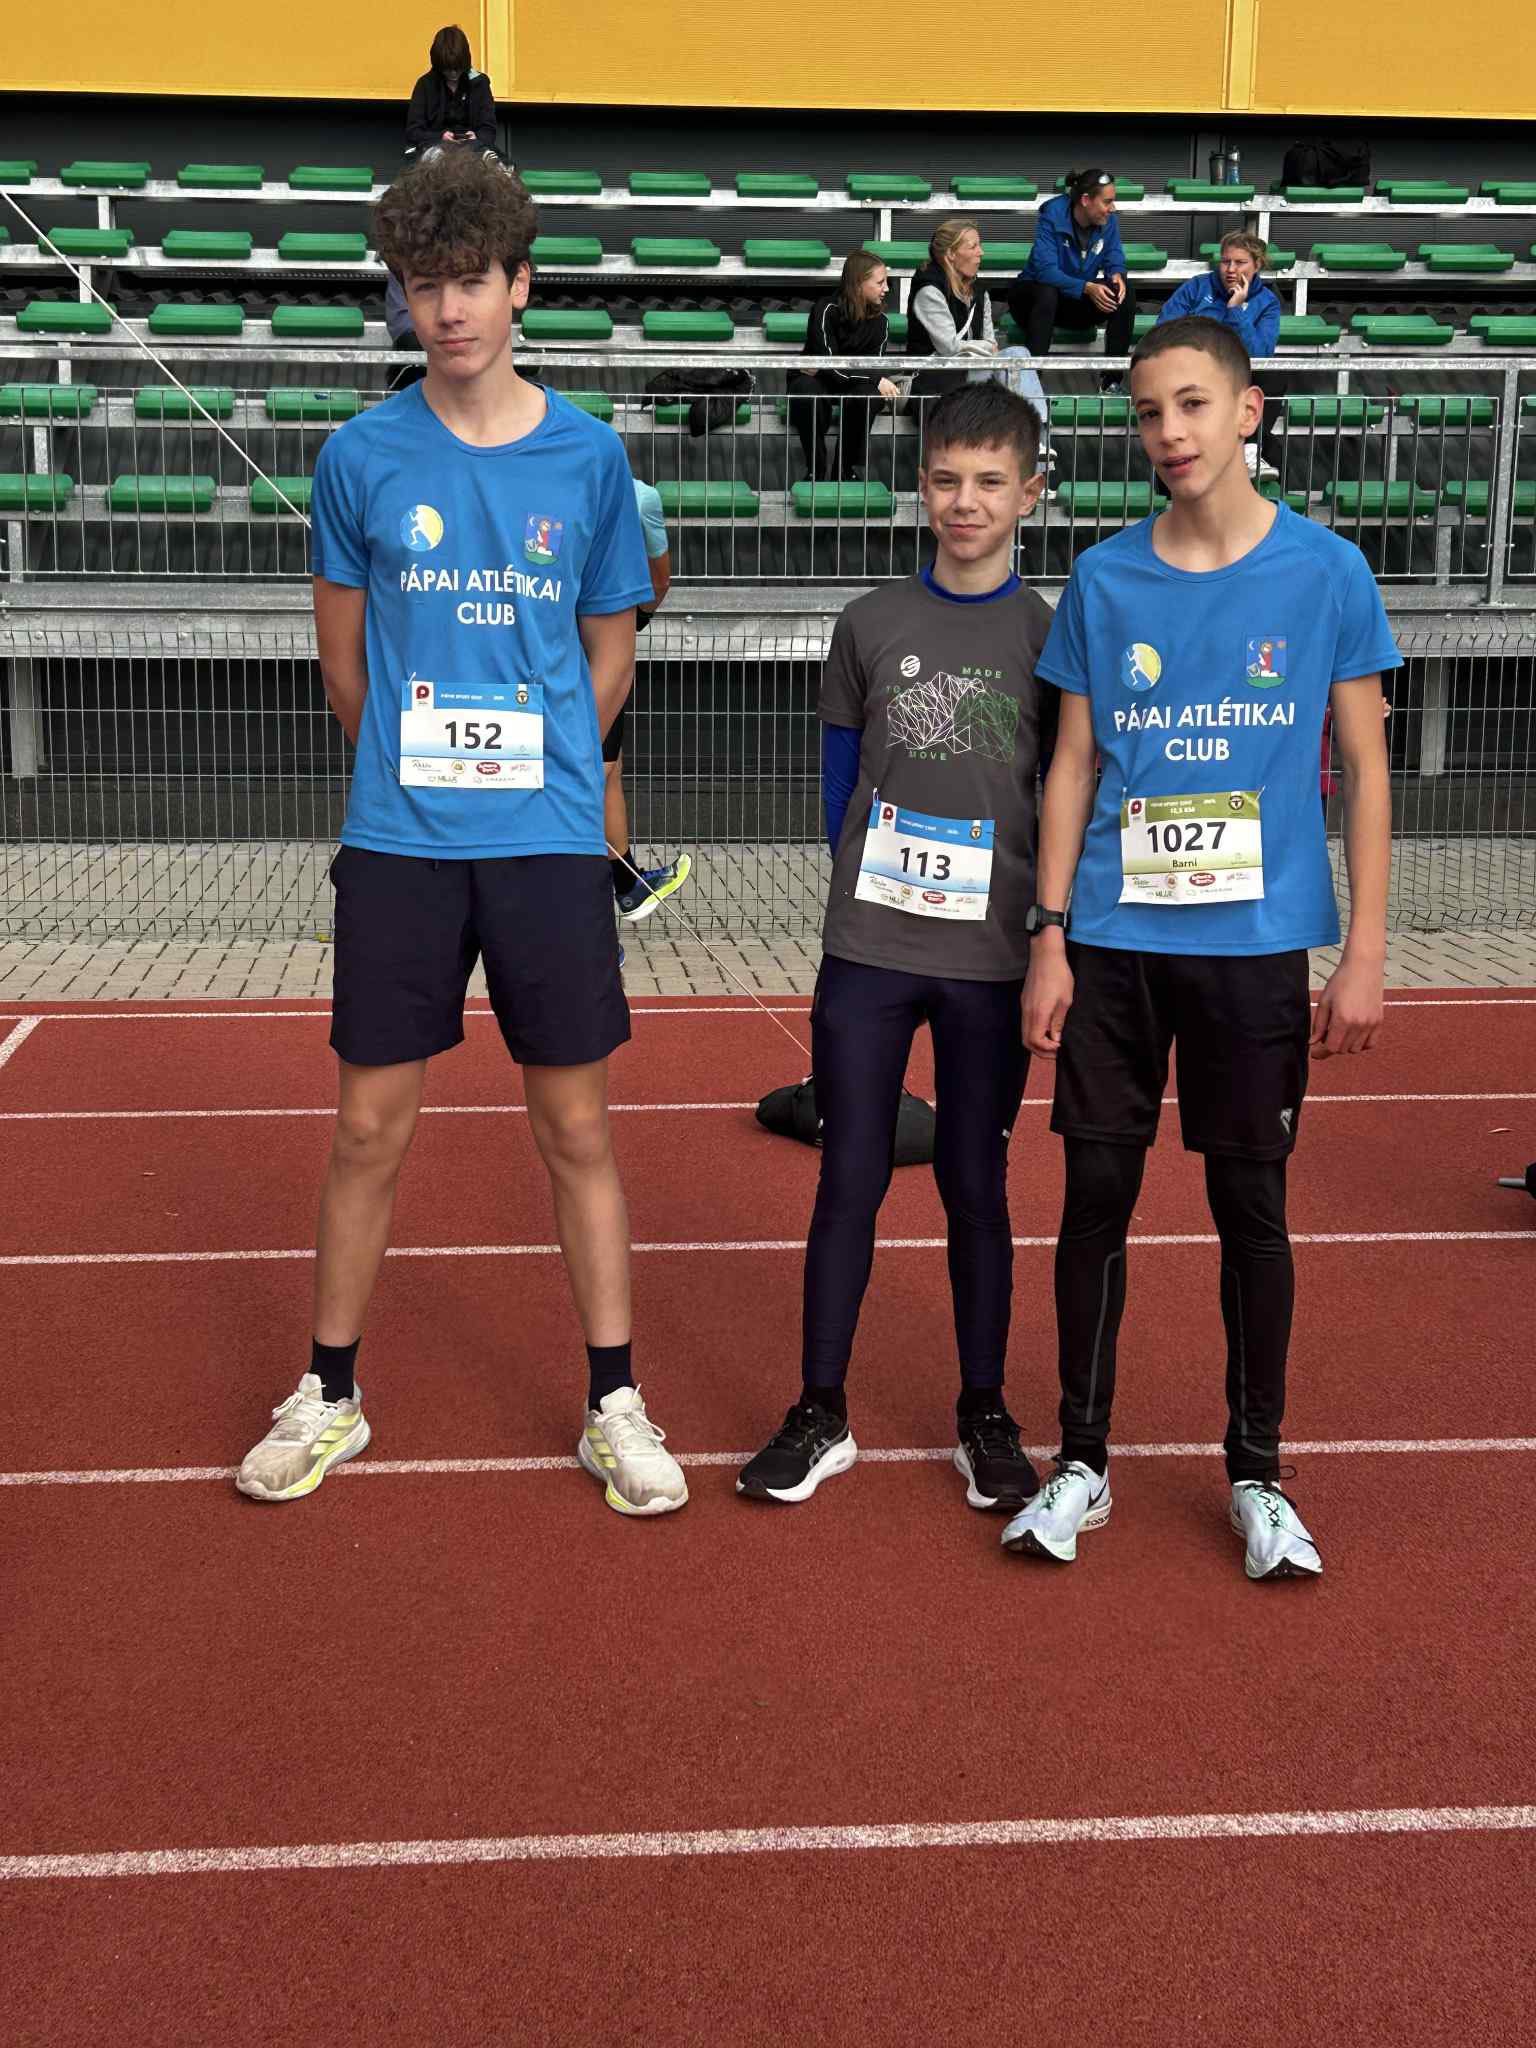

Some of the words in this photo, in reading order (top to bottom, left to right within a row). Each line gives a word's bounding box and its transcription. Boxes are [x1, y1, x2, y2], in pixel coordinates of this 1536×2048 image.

[400, 563, 459, 592] PÁPAI
[465, 564, 562, 602] ATLÉTIKAI
[456, 602, 516, 625] CLUB
[962, 666, 1003, 679] MADE
[1113, 702, 1171, 732] PÁAI
[1177, 696, 1296, 727] ATLÉTIKAI
[445, 720, 502, 750] 152
[1164, 738, 1231, 761] CLUB
[1147, 821, 1227, 854] 1027
[900, 847, 951, 881] 113
[1172, 858, 1198, 869] Barni
